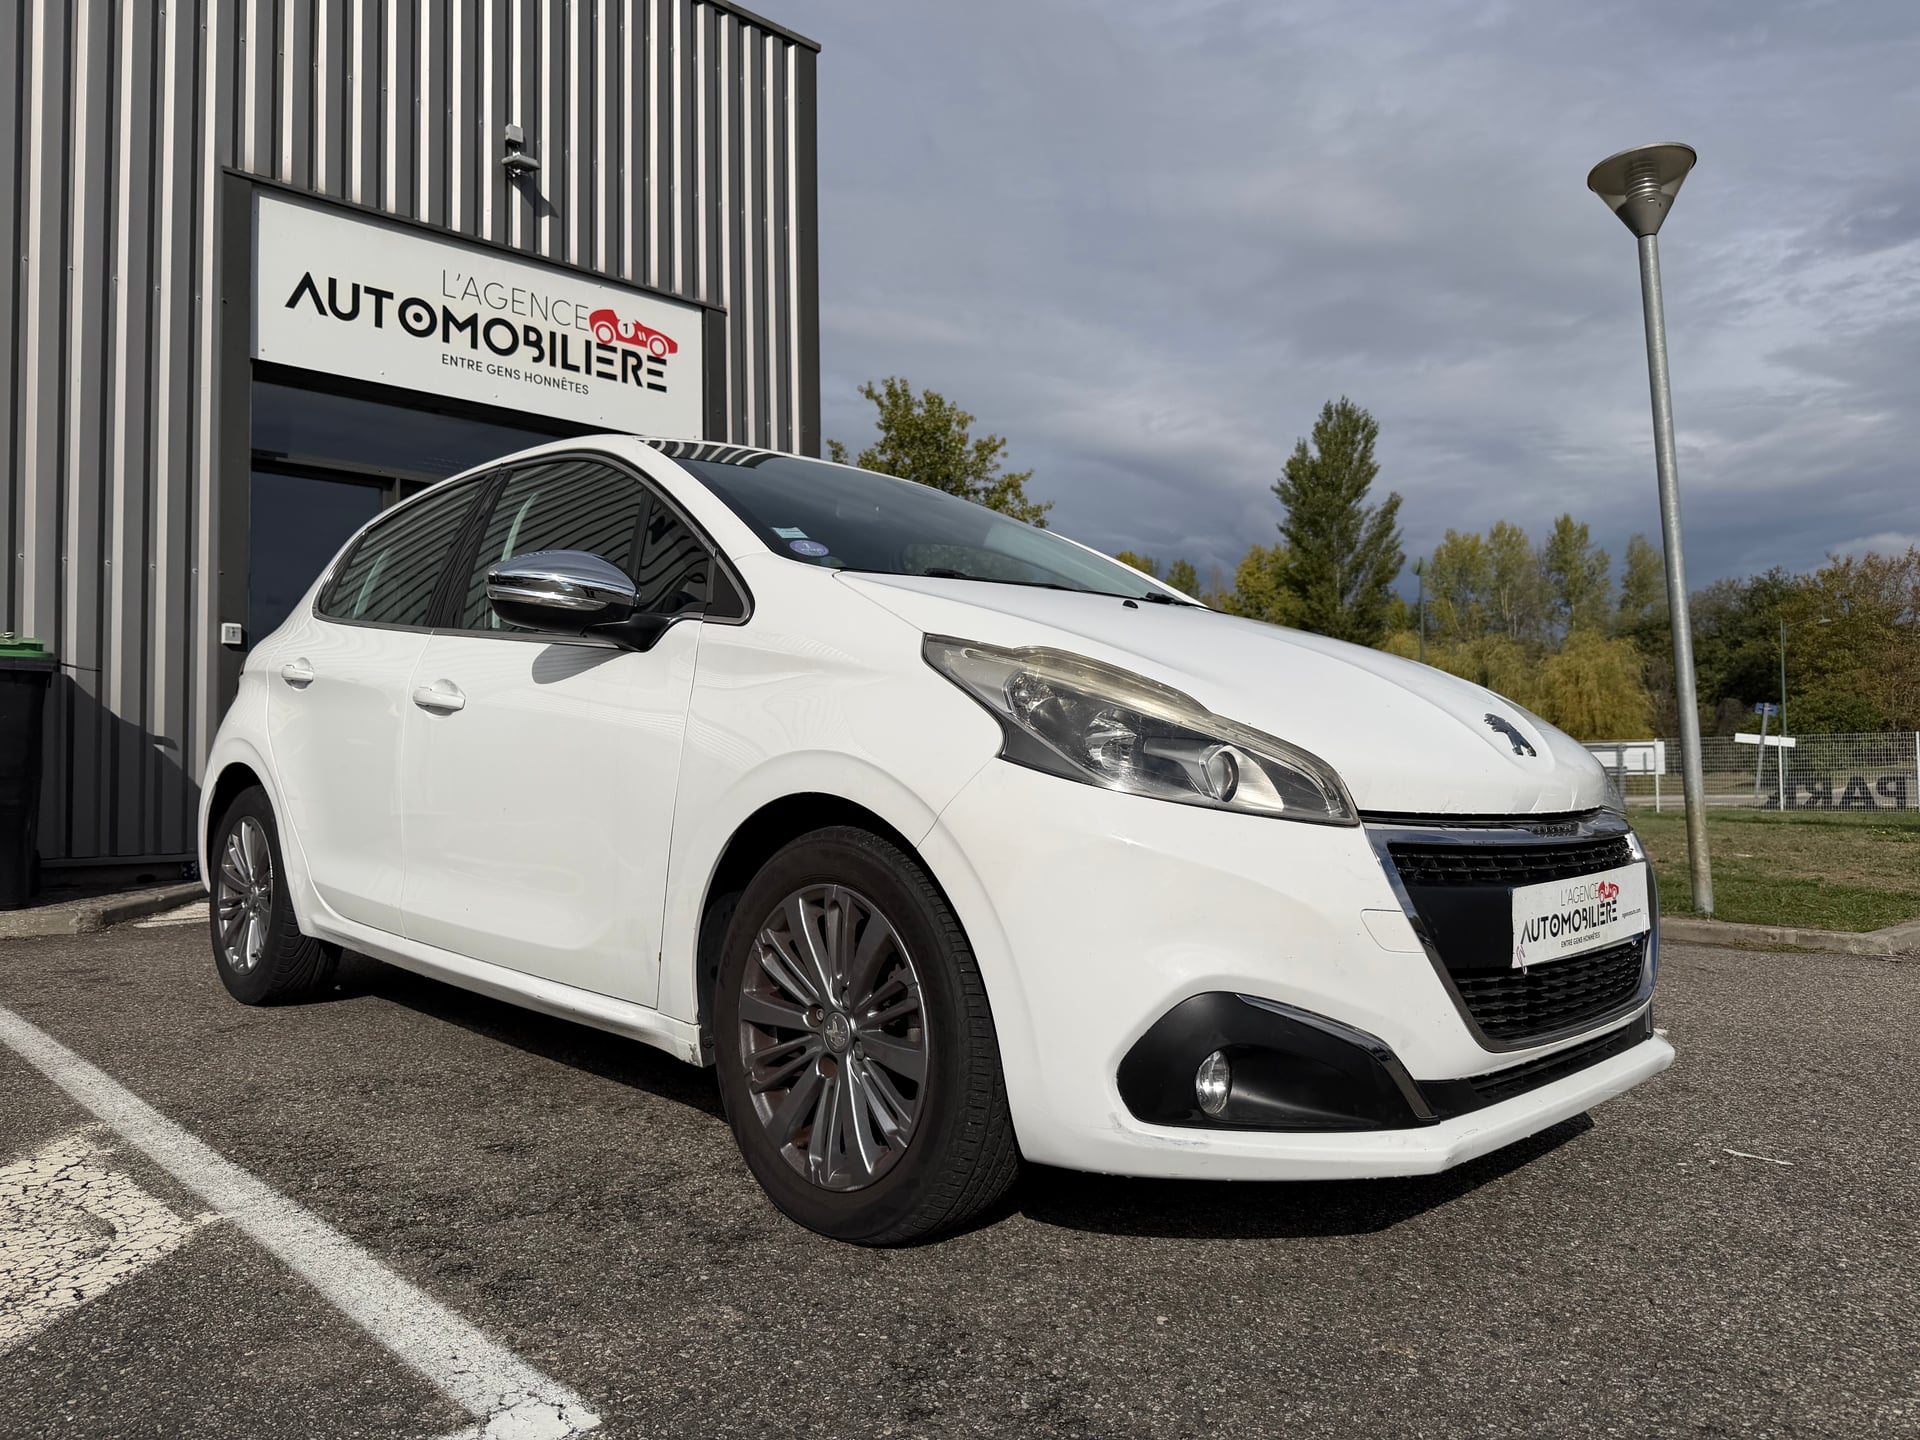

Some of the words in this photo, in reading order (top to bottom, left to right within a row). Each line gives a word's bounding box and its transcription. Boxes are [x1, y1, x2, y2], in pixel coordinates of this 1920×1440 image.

[441, 269, 590, 331] L'AGENCE
[622, 323, 629, 335] 1
[441, 353, 483, 372] ENTRE
[486, 363, 521, 381] GENS
[524, 373, 590, 395] HONNÊTES
[1560, 882, 1599, 907] L'AGENCE
